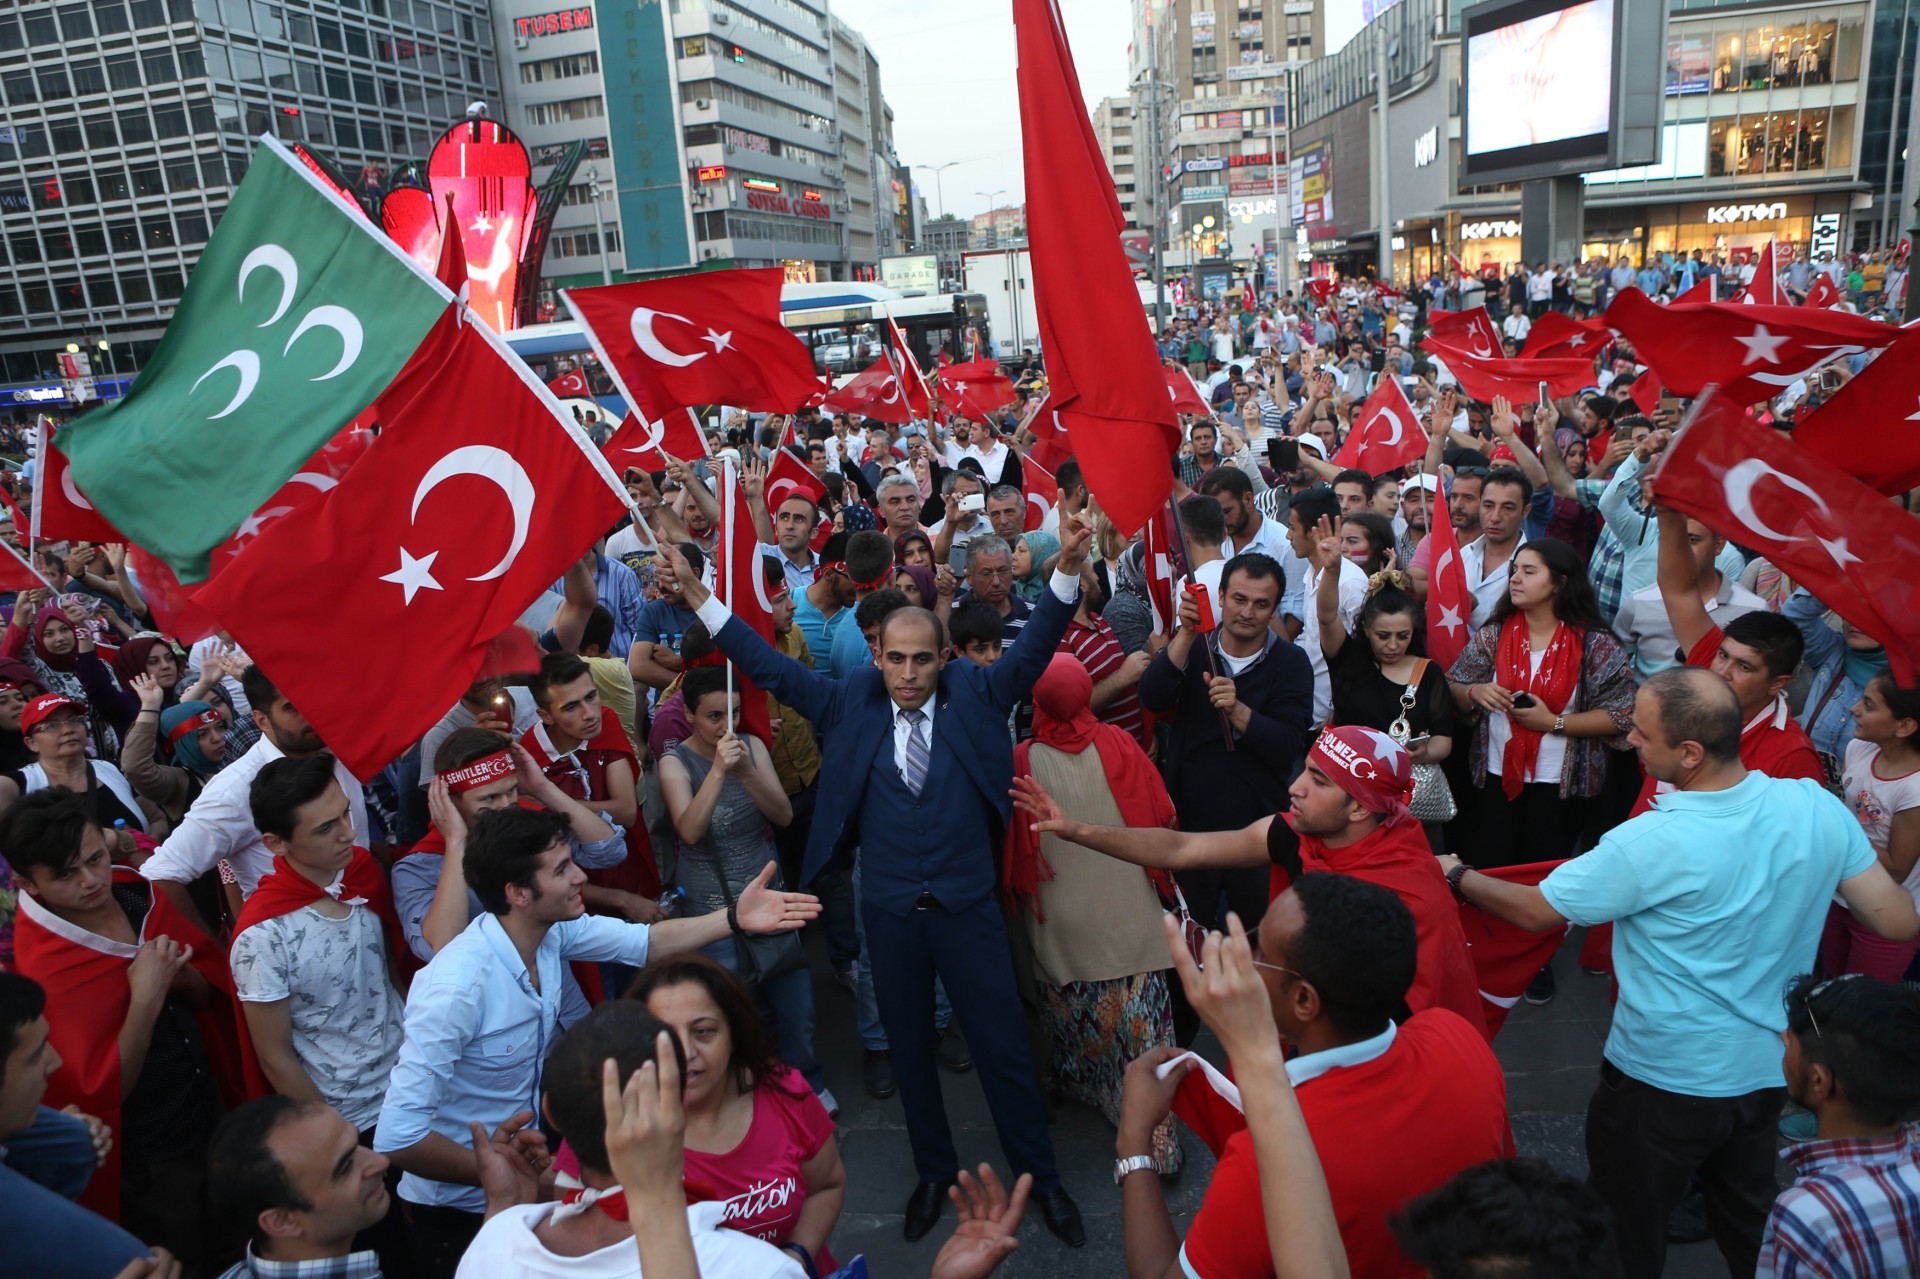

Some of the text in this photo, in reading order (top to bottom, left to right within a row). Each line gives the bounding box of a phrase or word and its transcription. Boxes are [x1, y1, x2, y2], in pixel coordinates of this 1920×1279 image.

[517, 8, 591, 36] TUSEM
[747, 192, 791, 213] SOYSAL
[1707, 202, 1787, 224] KOTON
[1461, 220, 1522, 240] KOTO
[890, 271, 931, 280] GARAGE
[469, 775, 491, 785] VATAN
